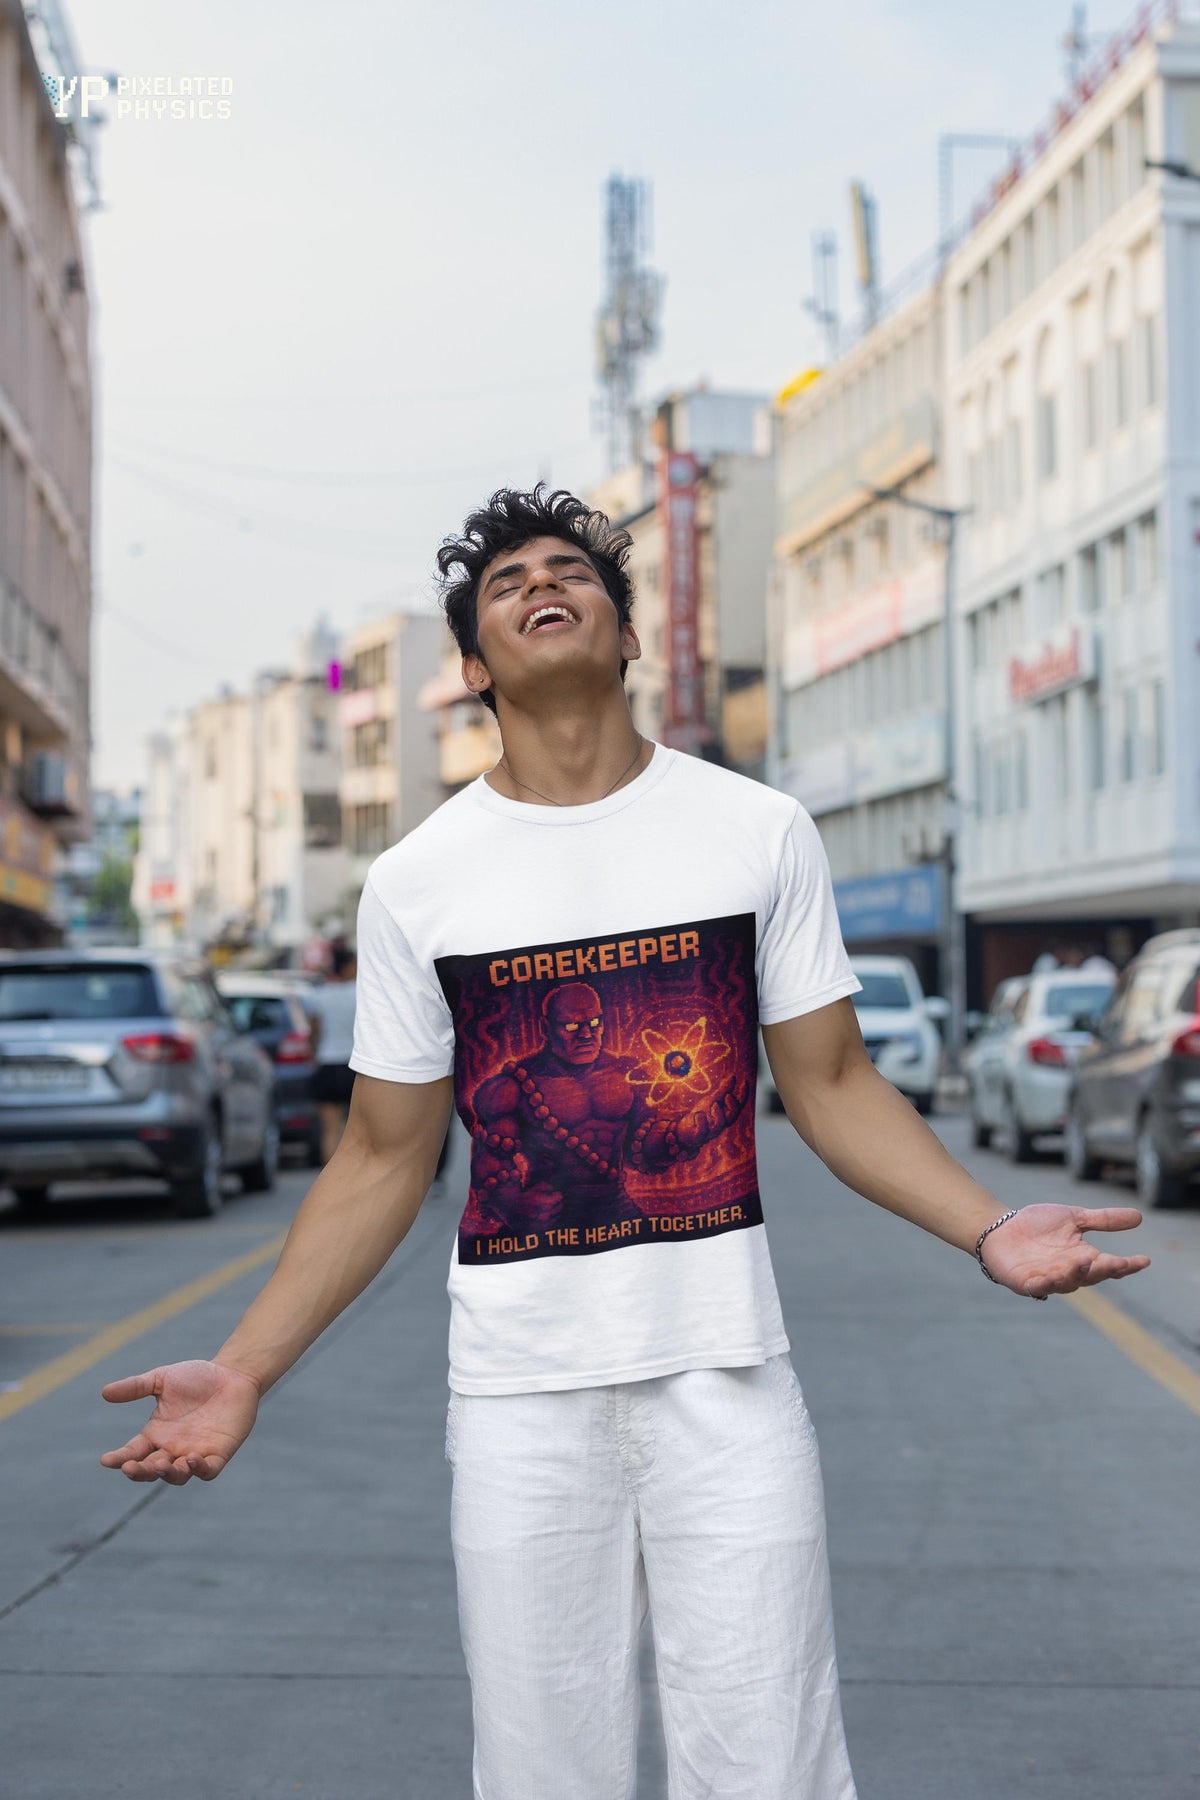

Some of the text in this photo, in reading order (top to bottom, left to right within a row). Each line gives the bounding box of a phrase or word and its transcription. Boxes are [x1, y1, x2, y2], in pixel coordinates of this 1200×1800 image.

[489, 930, 700, 987] COREKEEPER
[476, 1205, 747, 1256] I HOLD THE HEART TOGETHER.
